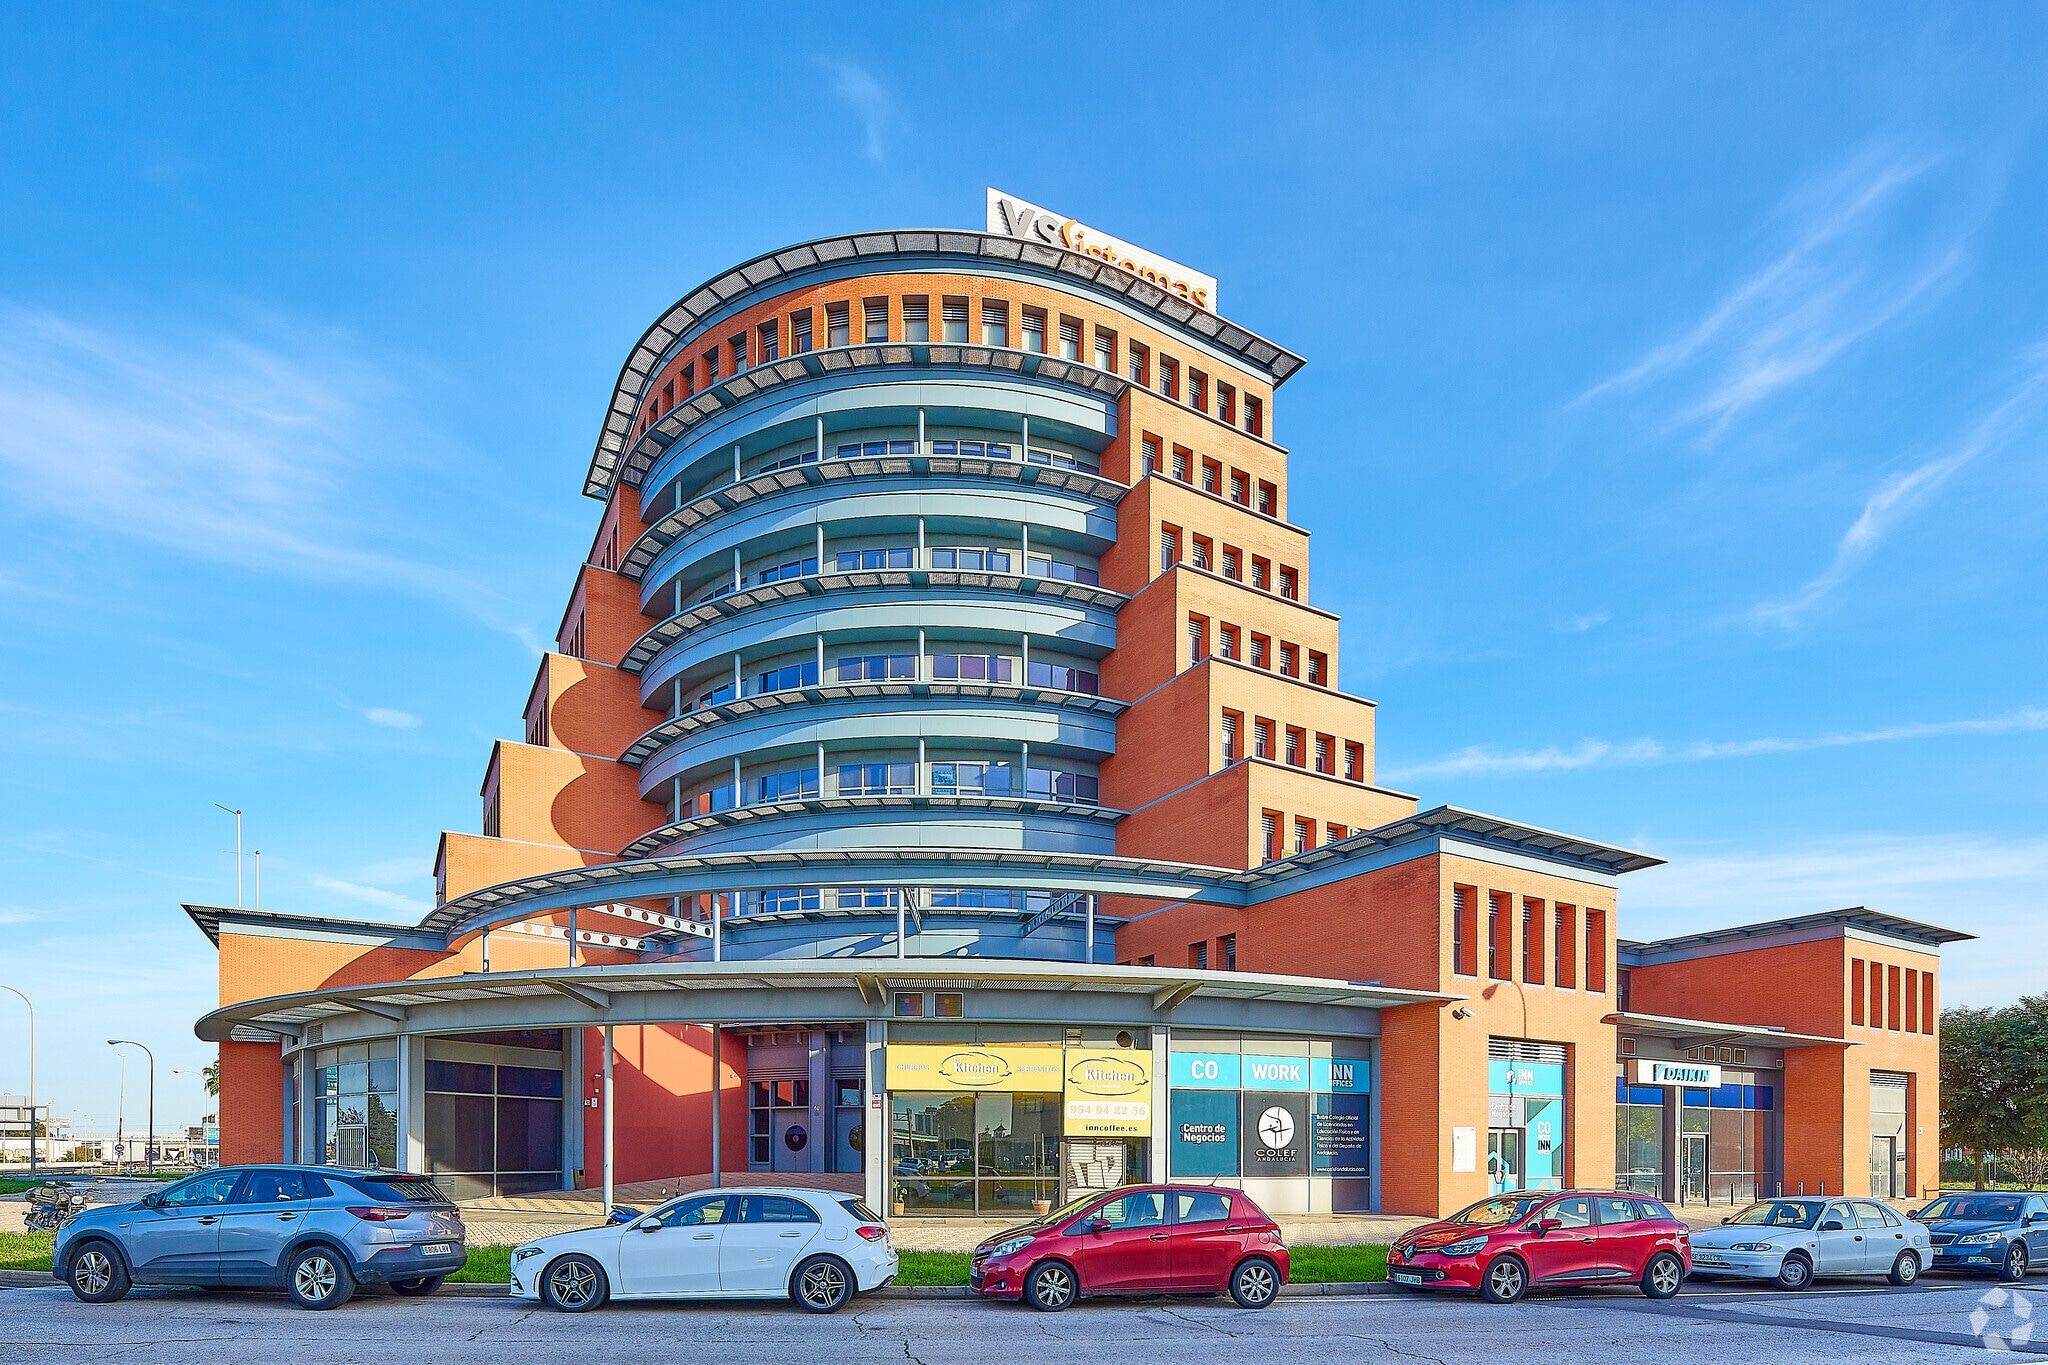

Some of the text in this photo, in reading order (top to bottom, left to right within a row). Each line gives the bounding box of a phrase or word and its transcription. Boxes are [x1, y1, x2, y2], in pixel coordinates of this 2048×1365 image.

[895, 1063, 929, 1071] CHURROS
[953, 1062, 999, 1073] Kitchen
[1016, 1065, 1060, 1073] SERRANITOS
[1191, 1060, 1218, 1080] CO
[1251, 1063, 1302, 1082] WORK
[1328, 1063, 1353, 1080] INN
[1085, 1070, 1135, 1081] Kitchen
[1518, 1069, 1534, 1080] INN
[1664, 1067, 1710, 1082] DAIKIN
[1070, 1105, 1146, 1116] 954 94 22 56
[1085, 1124, 1138, 1132] inncoffee.es
[1183, 1123, 1226, 1133] Centro de
[1537, 1121, 1551, 1134] CO
[1183, 1133, 1226, 1144] Negocios
[1537, 1140, 1551, 1151] INN
[1255, 1149, 1298, 1157] COLEF
